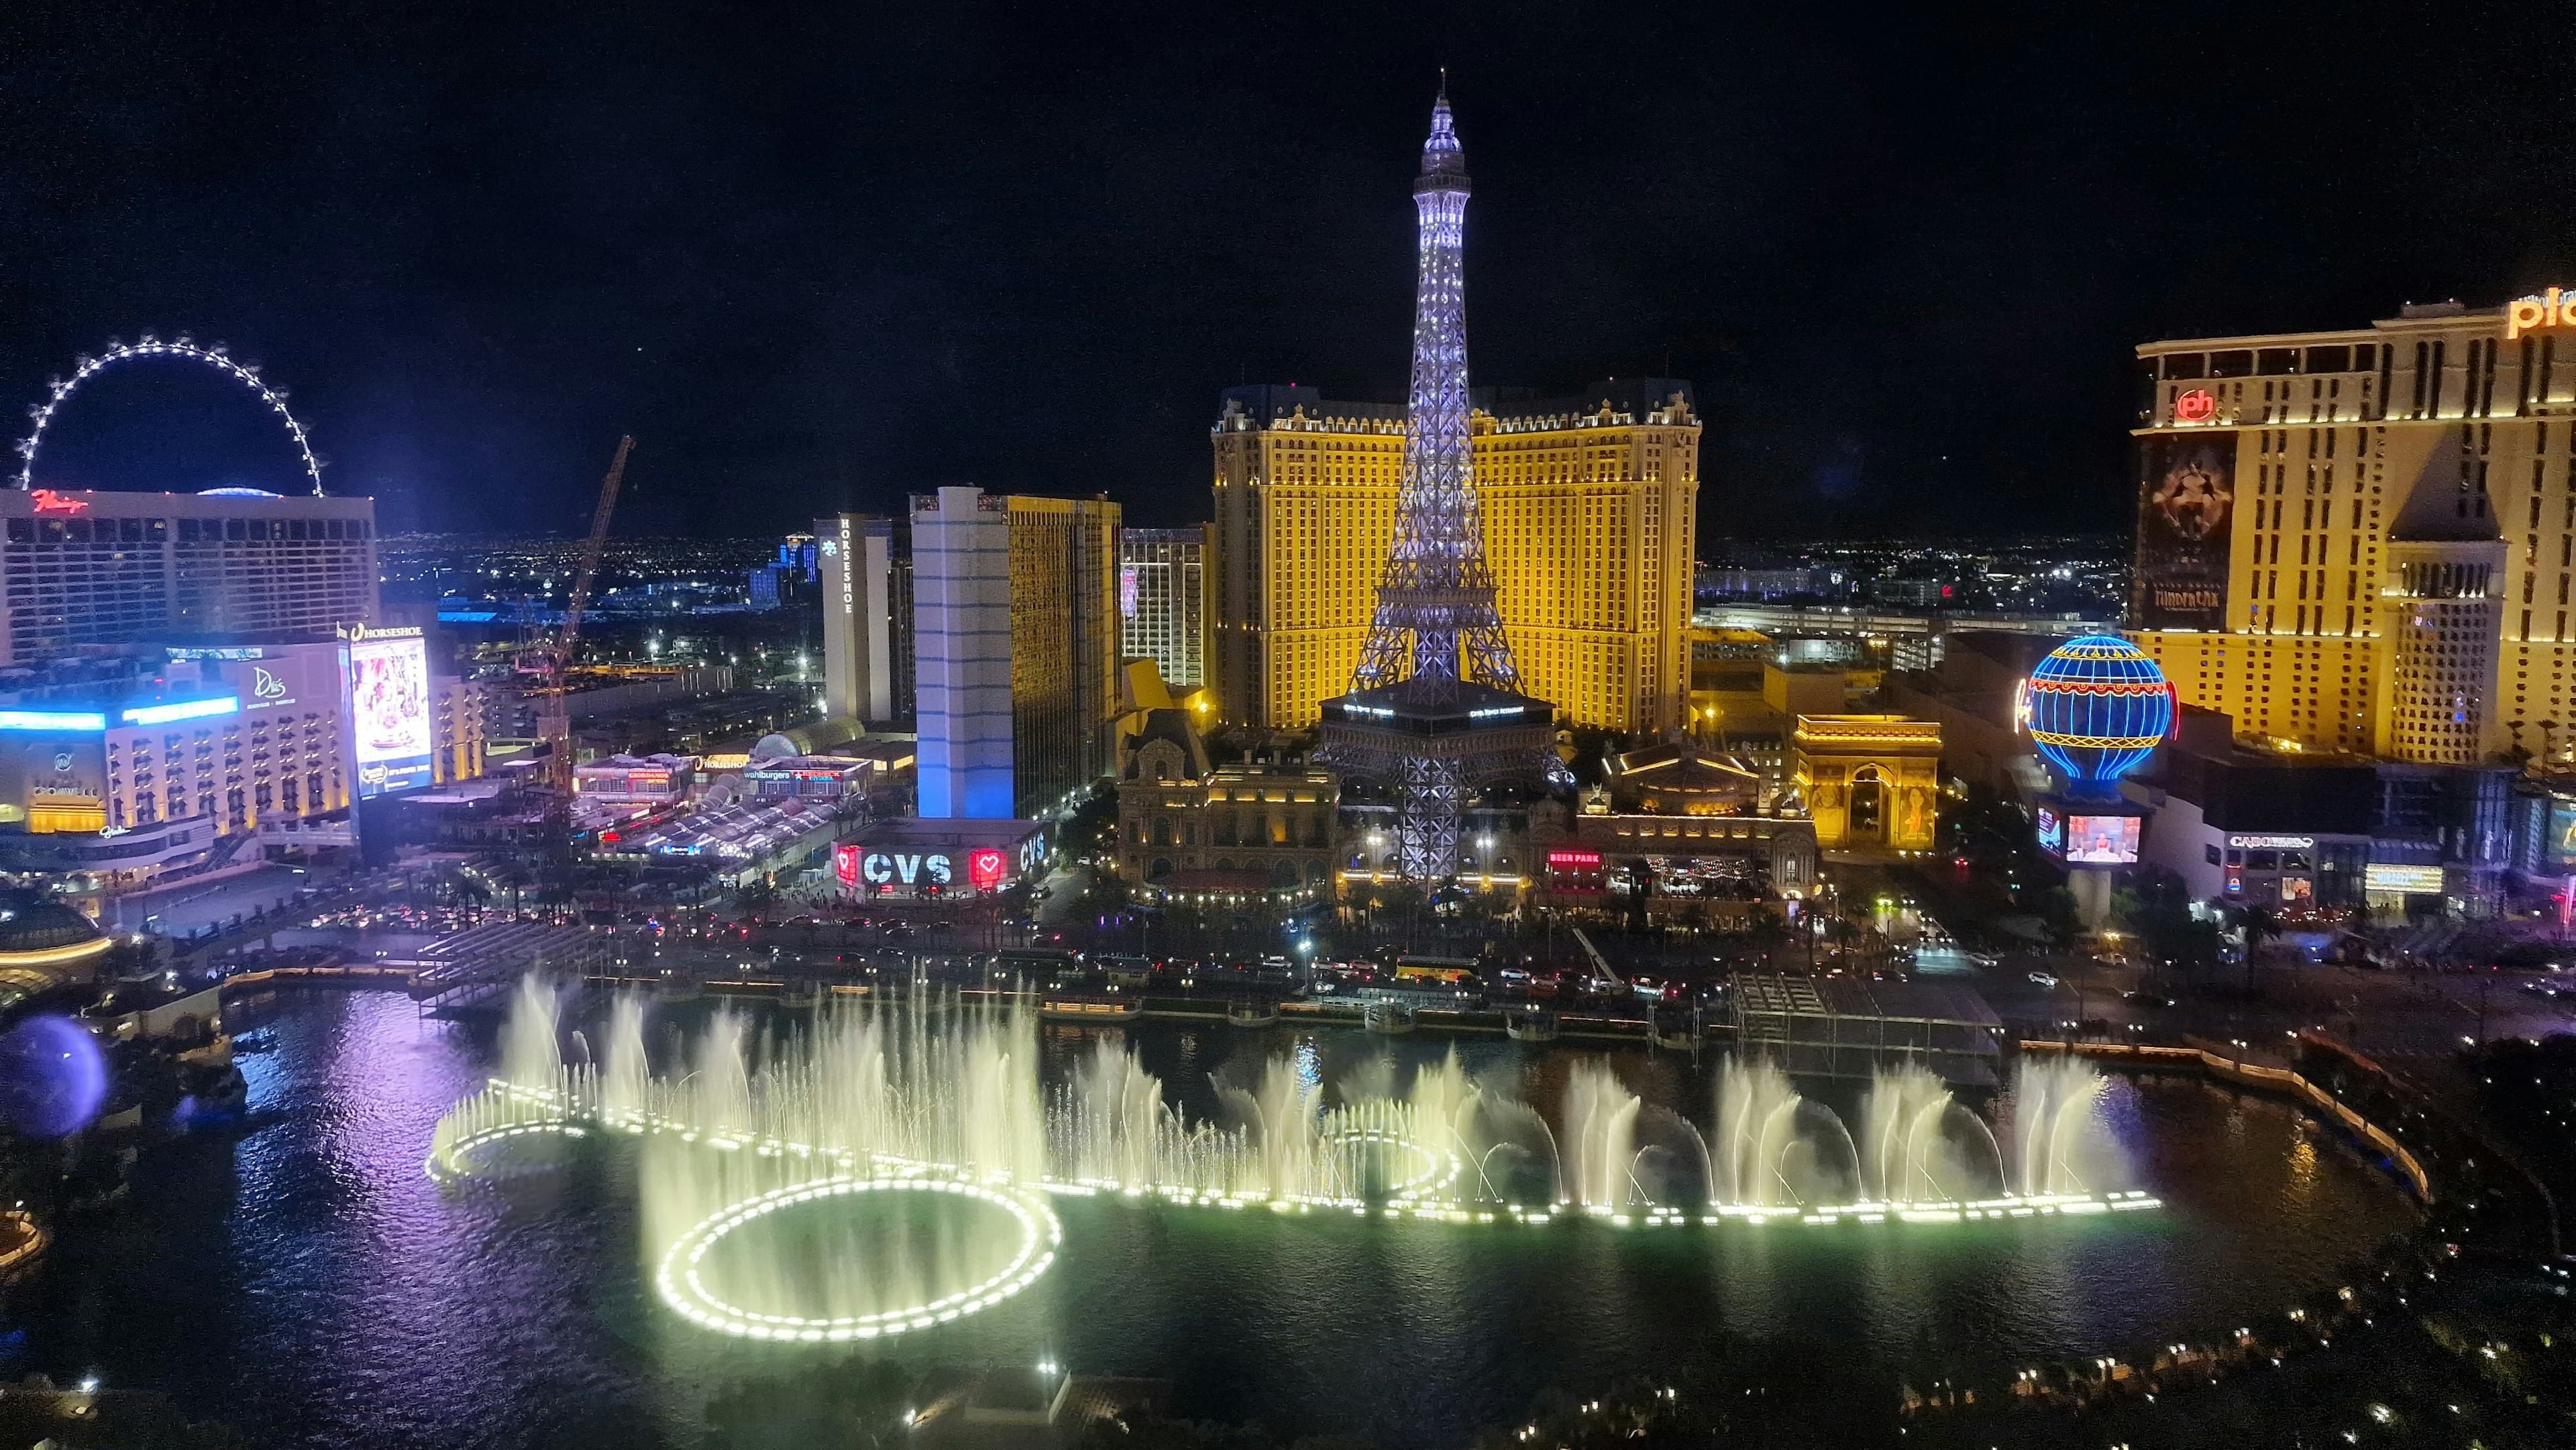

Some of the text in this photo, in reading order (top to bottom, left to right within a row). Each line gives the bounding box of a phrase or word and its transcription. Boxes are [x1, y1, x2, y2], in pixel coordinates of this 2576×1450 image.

[2182, 390, 2213, 416] ph
[841, 519, 852, 613] HORSESHOE
[364, 626, 423, 638] HORSESHOE
[744, 771, 790, 779] wahlburgers
[1020, 831, 1044, 872] CVS
[1549, 853, 1599, 863] BEER PARK
[863, 854, 951, 884] CVS
